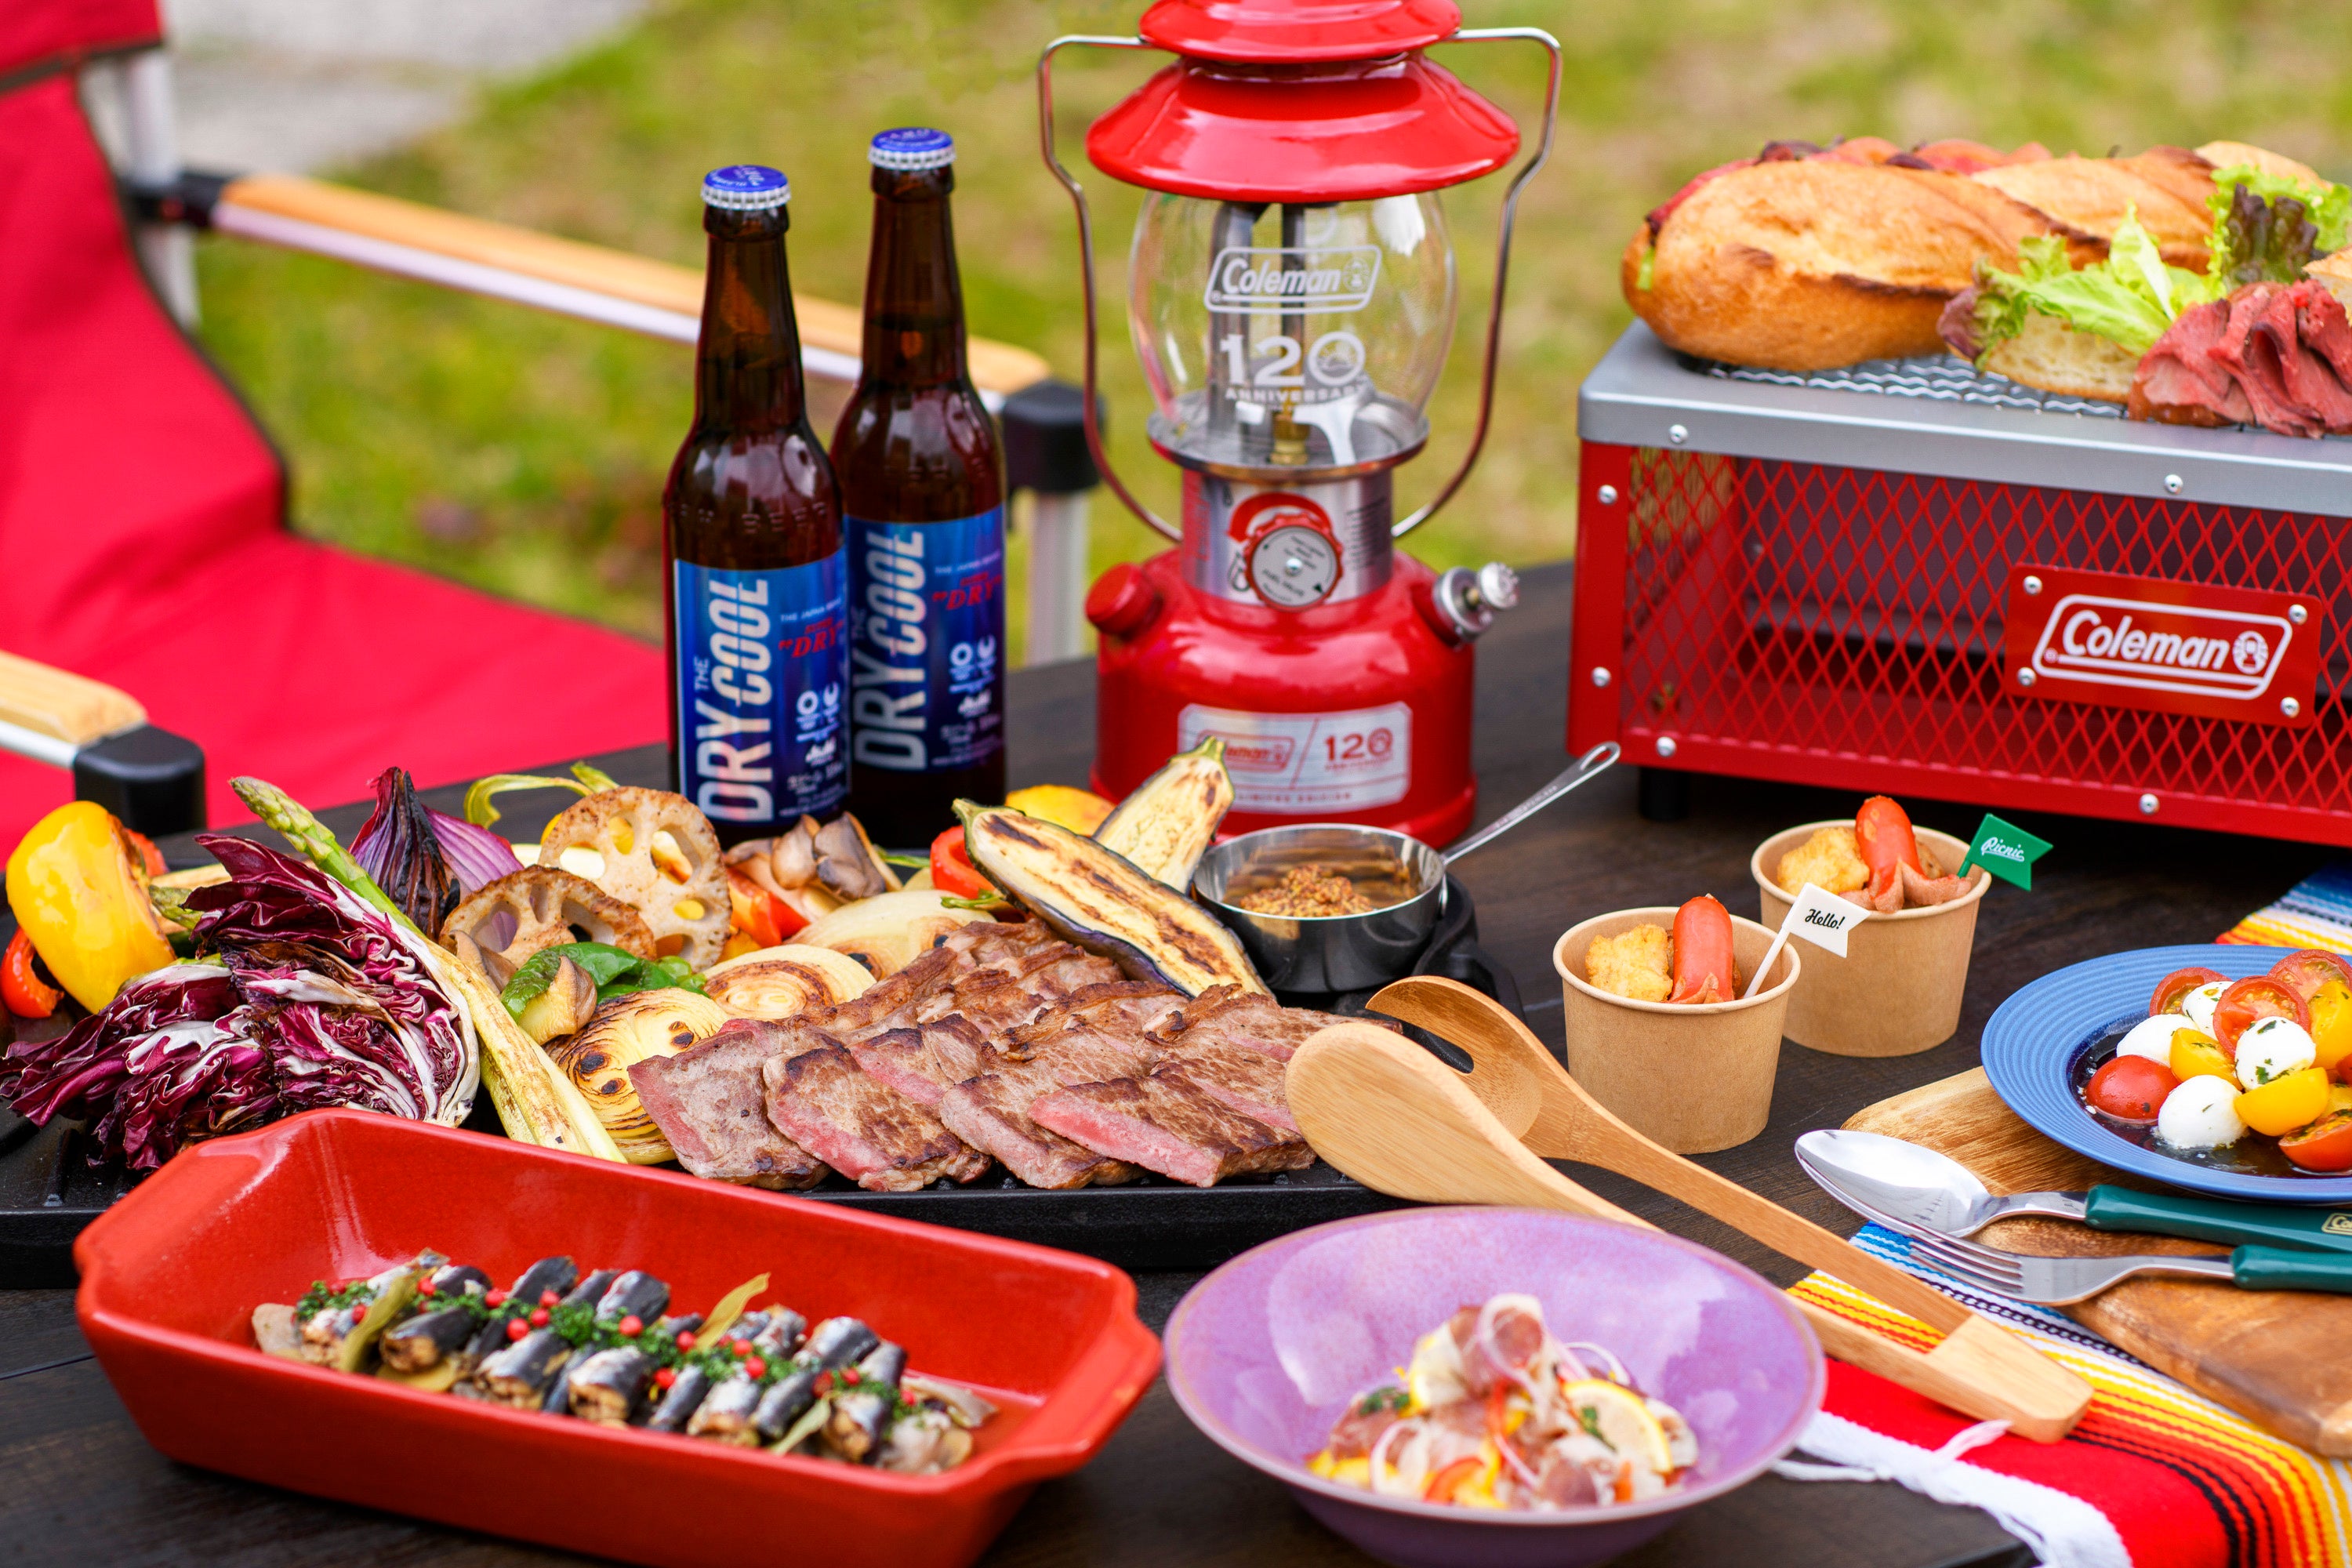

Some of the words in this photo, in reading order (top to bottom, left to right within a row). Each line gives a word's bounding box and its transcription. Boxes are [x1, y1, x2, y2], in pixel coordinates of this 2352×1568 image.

[1222, 257, 1341, 295] Coleman
[1220, 332, 1366, 387] 120
[865, 531, 927, 657] COOL
[709, 579, 771, 706] COOL
[2062, 608, 2230, 670] Coleman
[693, 655, 710, 691] THE
[852, 648, 928, 771] DRY
[695, 697, 775, 822] DRY
[1324, 727, 1394, 761] 120
[1805, 908, 1846, 930] Hello!
